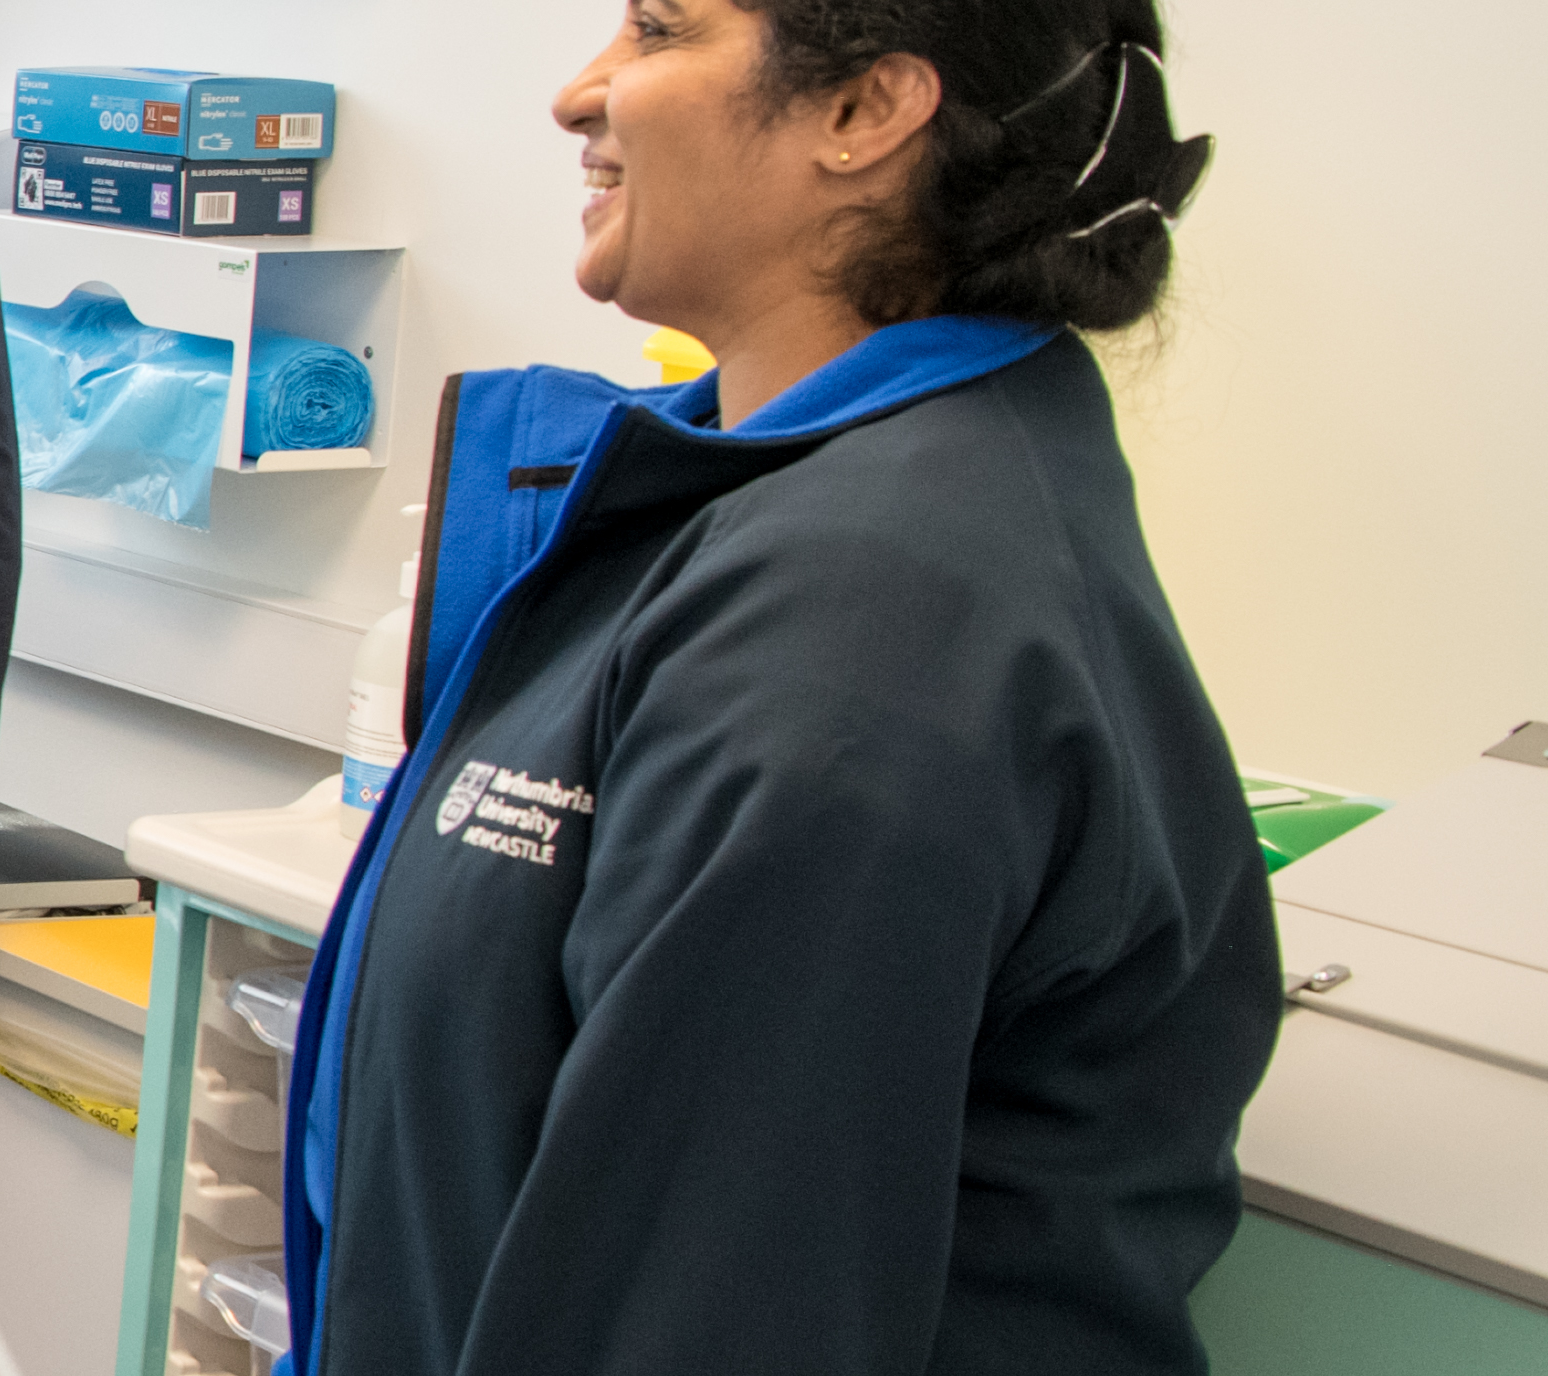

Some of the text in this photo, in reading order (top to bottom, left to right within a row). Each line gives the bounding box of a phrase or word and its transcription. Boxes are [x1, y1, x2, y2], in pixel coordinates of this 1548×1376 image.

[200, 96, 240, 104] MERCATOR
[146, 106, 157, 121] XL
[260, 121, 276, 136] XL
[191, 169, 207, 177] BLUE
[244, 168, 266, 176] NITRILE
[285, 167, 308, 175] GLOVES
[154, 190, 169, 206] XS
[281, 197, 299, 211] XS
[489, 767, 595, 814] Northumbria
[475, 794, 562, 842] University
[461, 825, 556, 867] NEWCASTLE
